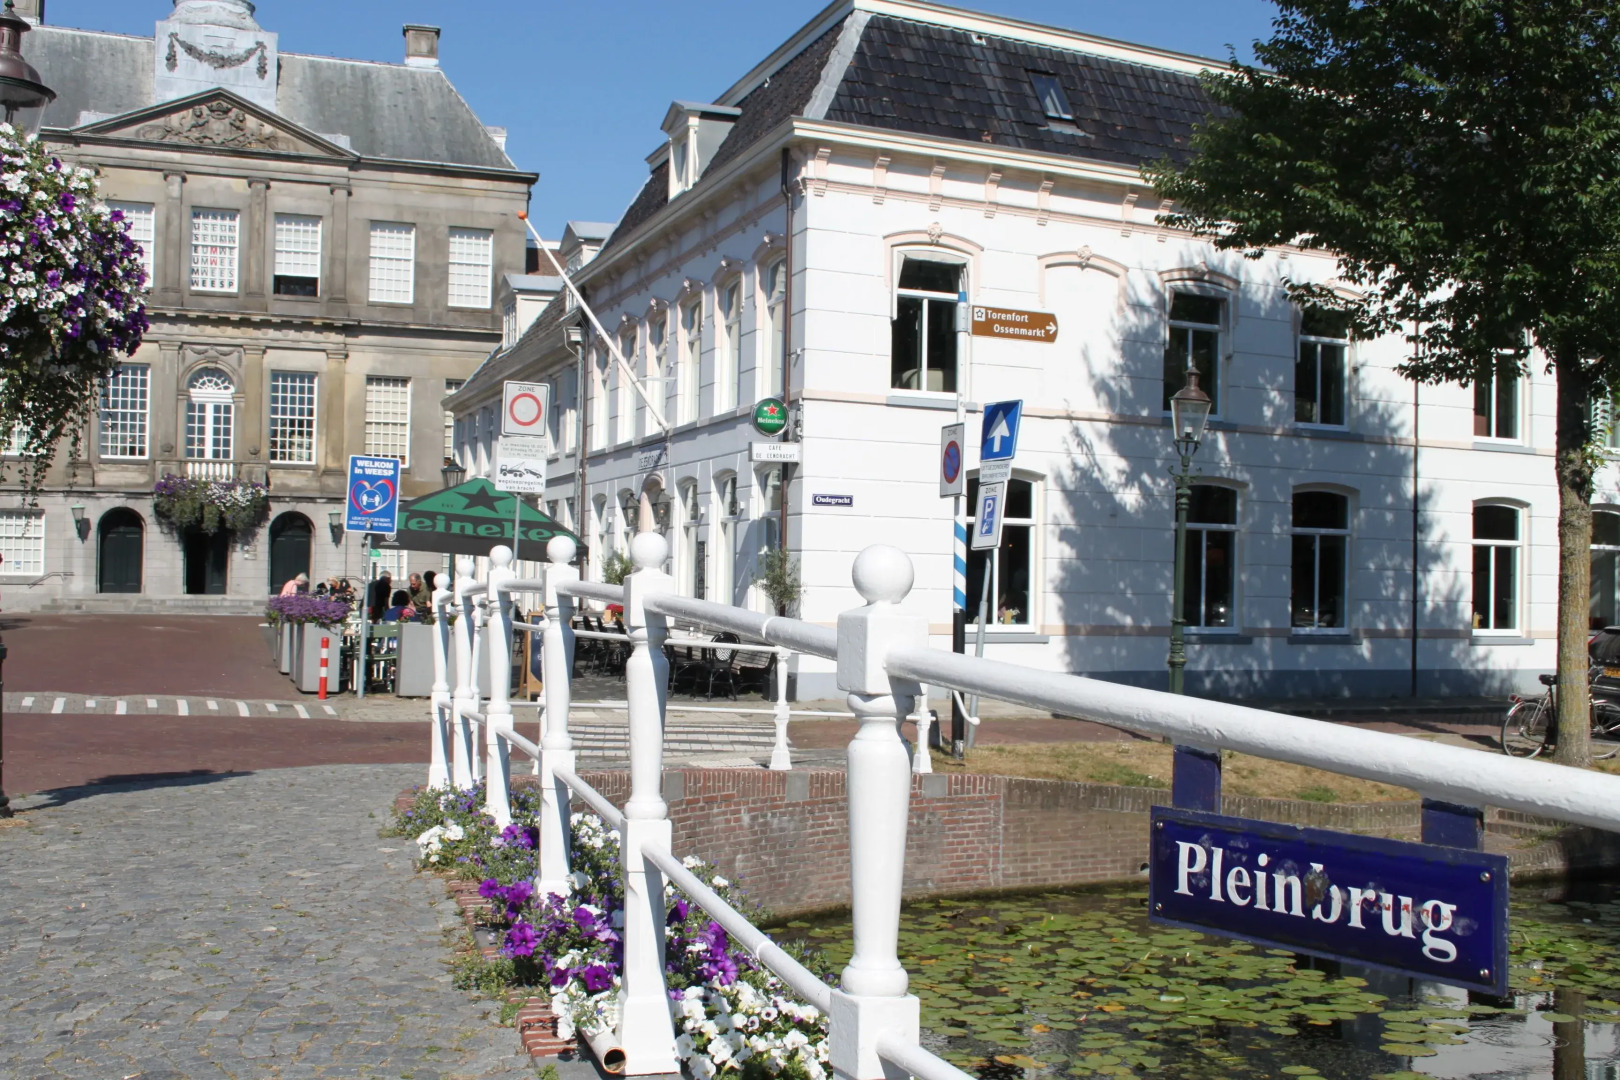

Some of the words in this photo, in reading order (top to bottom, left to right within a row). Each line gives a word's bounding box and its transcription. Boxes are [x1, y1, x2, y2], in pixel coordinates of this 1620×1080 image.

[192, 279, 234, 288] WEESP
[987, 310, 1029, 322] Torenfort
[993, 323, 1045, 337] Ossenmarkt
[356, 460, 394, 469] WELKOM
[364, 468, 394, 476] WEESP
[985, 486, 997, 494] ZONE
[815, 496, 851, 504] Oudegracht
[1173, 840, 1458, 963] Pleinbrug
